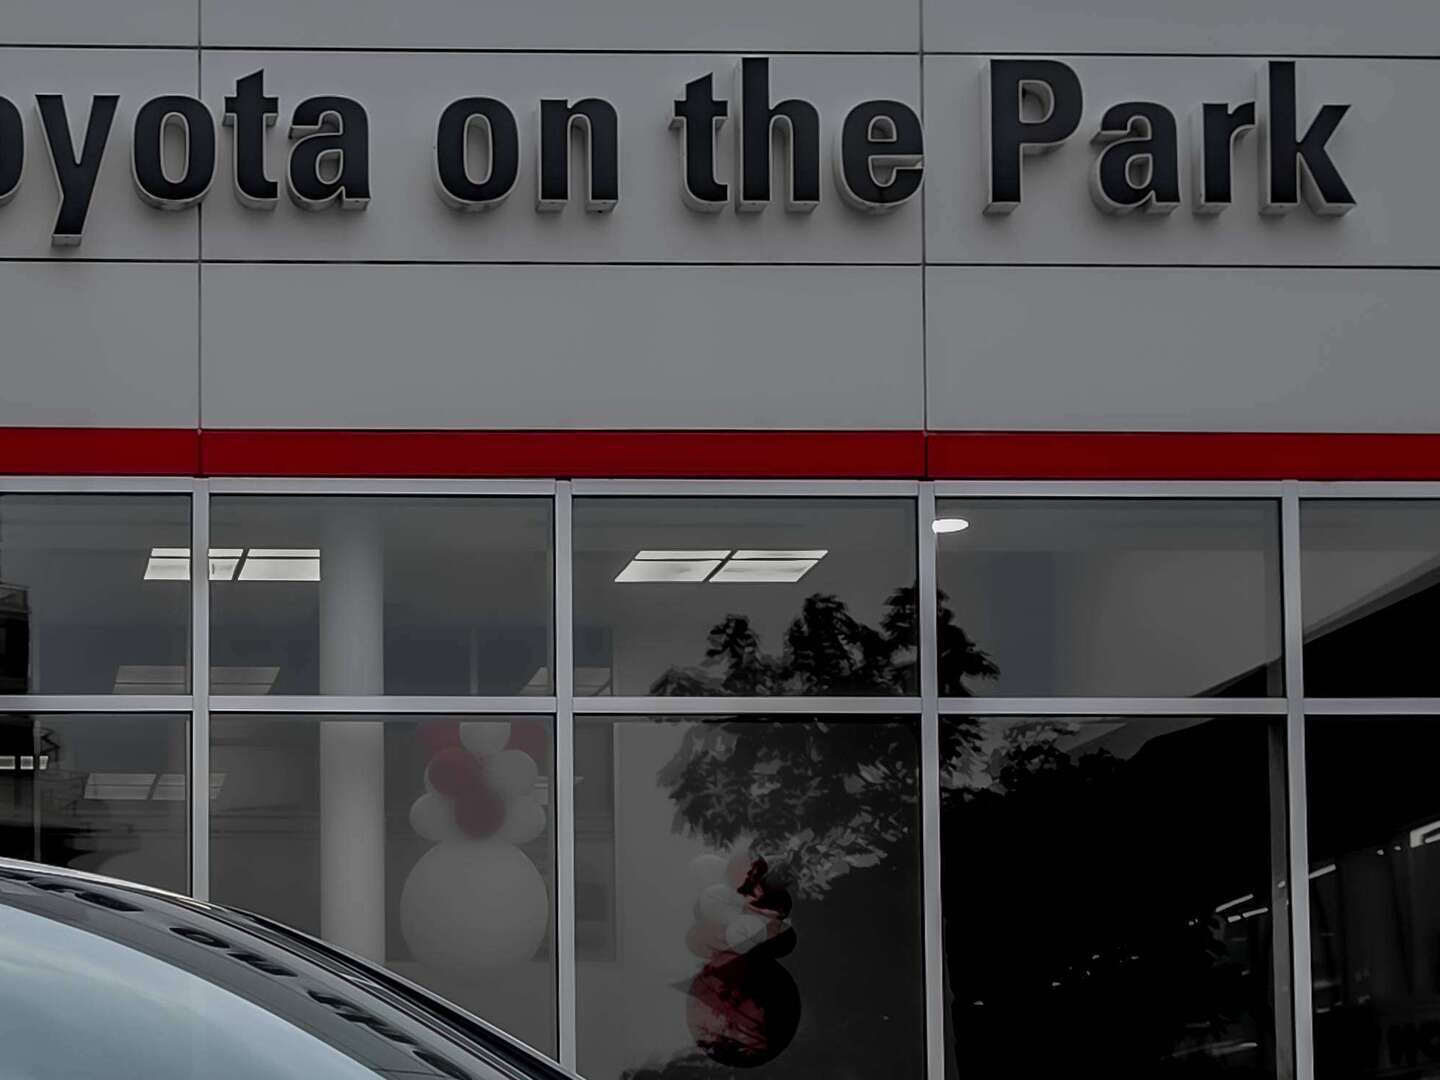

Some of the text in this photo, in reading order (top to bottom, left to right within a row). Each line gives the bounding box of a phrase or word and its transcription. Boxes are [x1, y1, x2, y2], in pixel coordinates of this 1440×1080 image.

[436, 96, 618, 210] on
[670, 56, 924, 210] the
[985, 58, 1357, 214] Park
